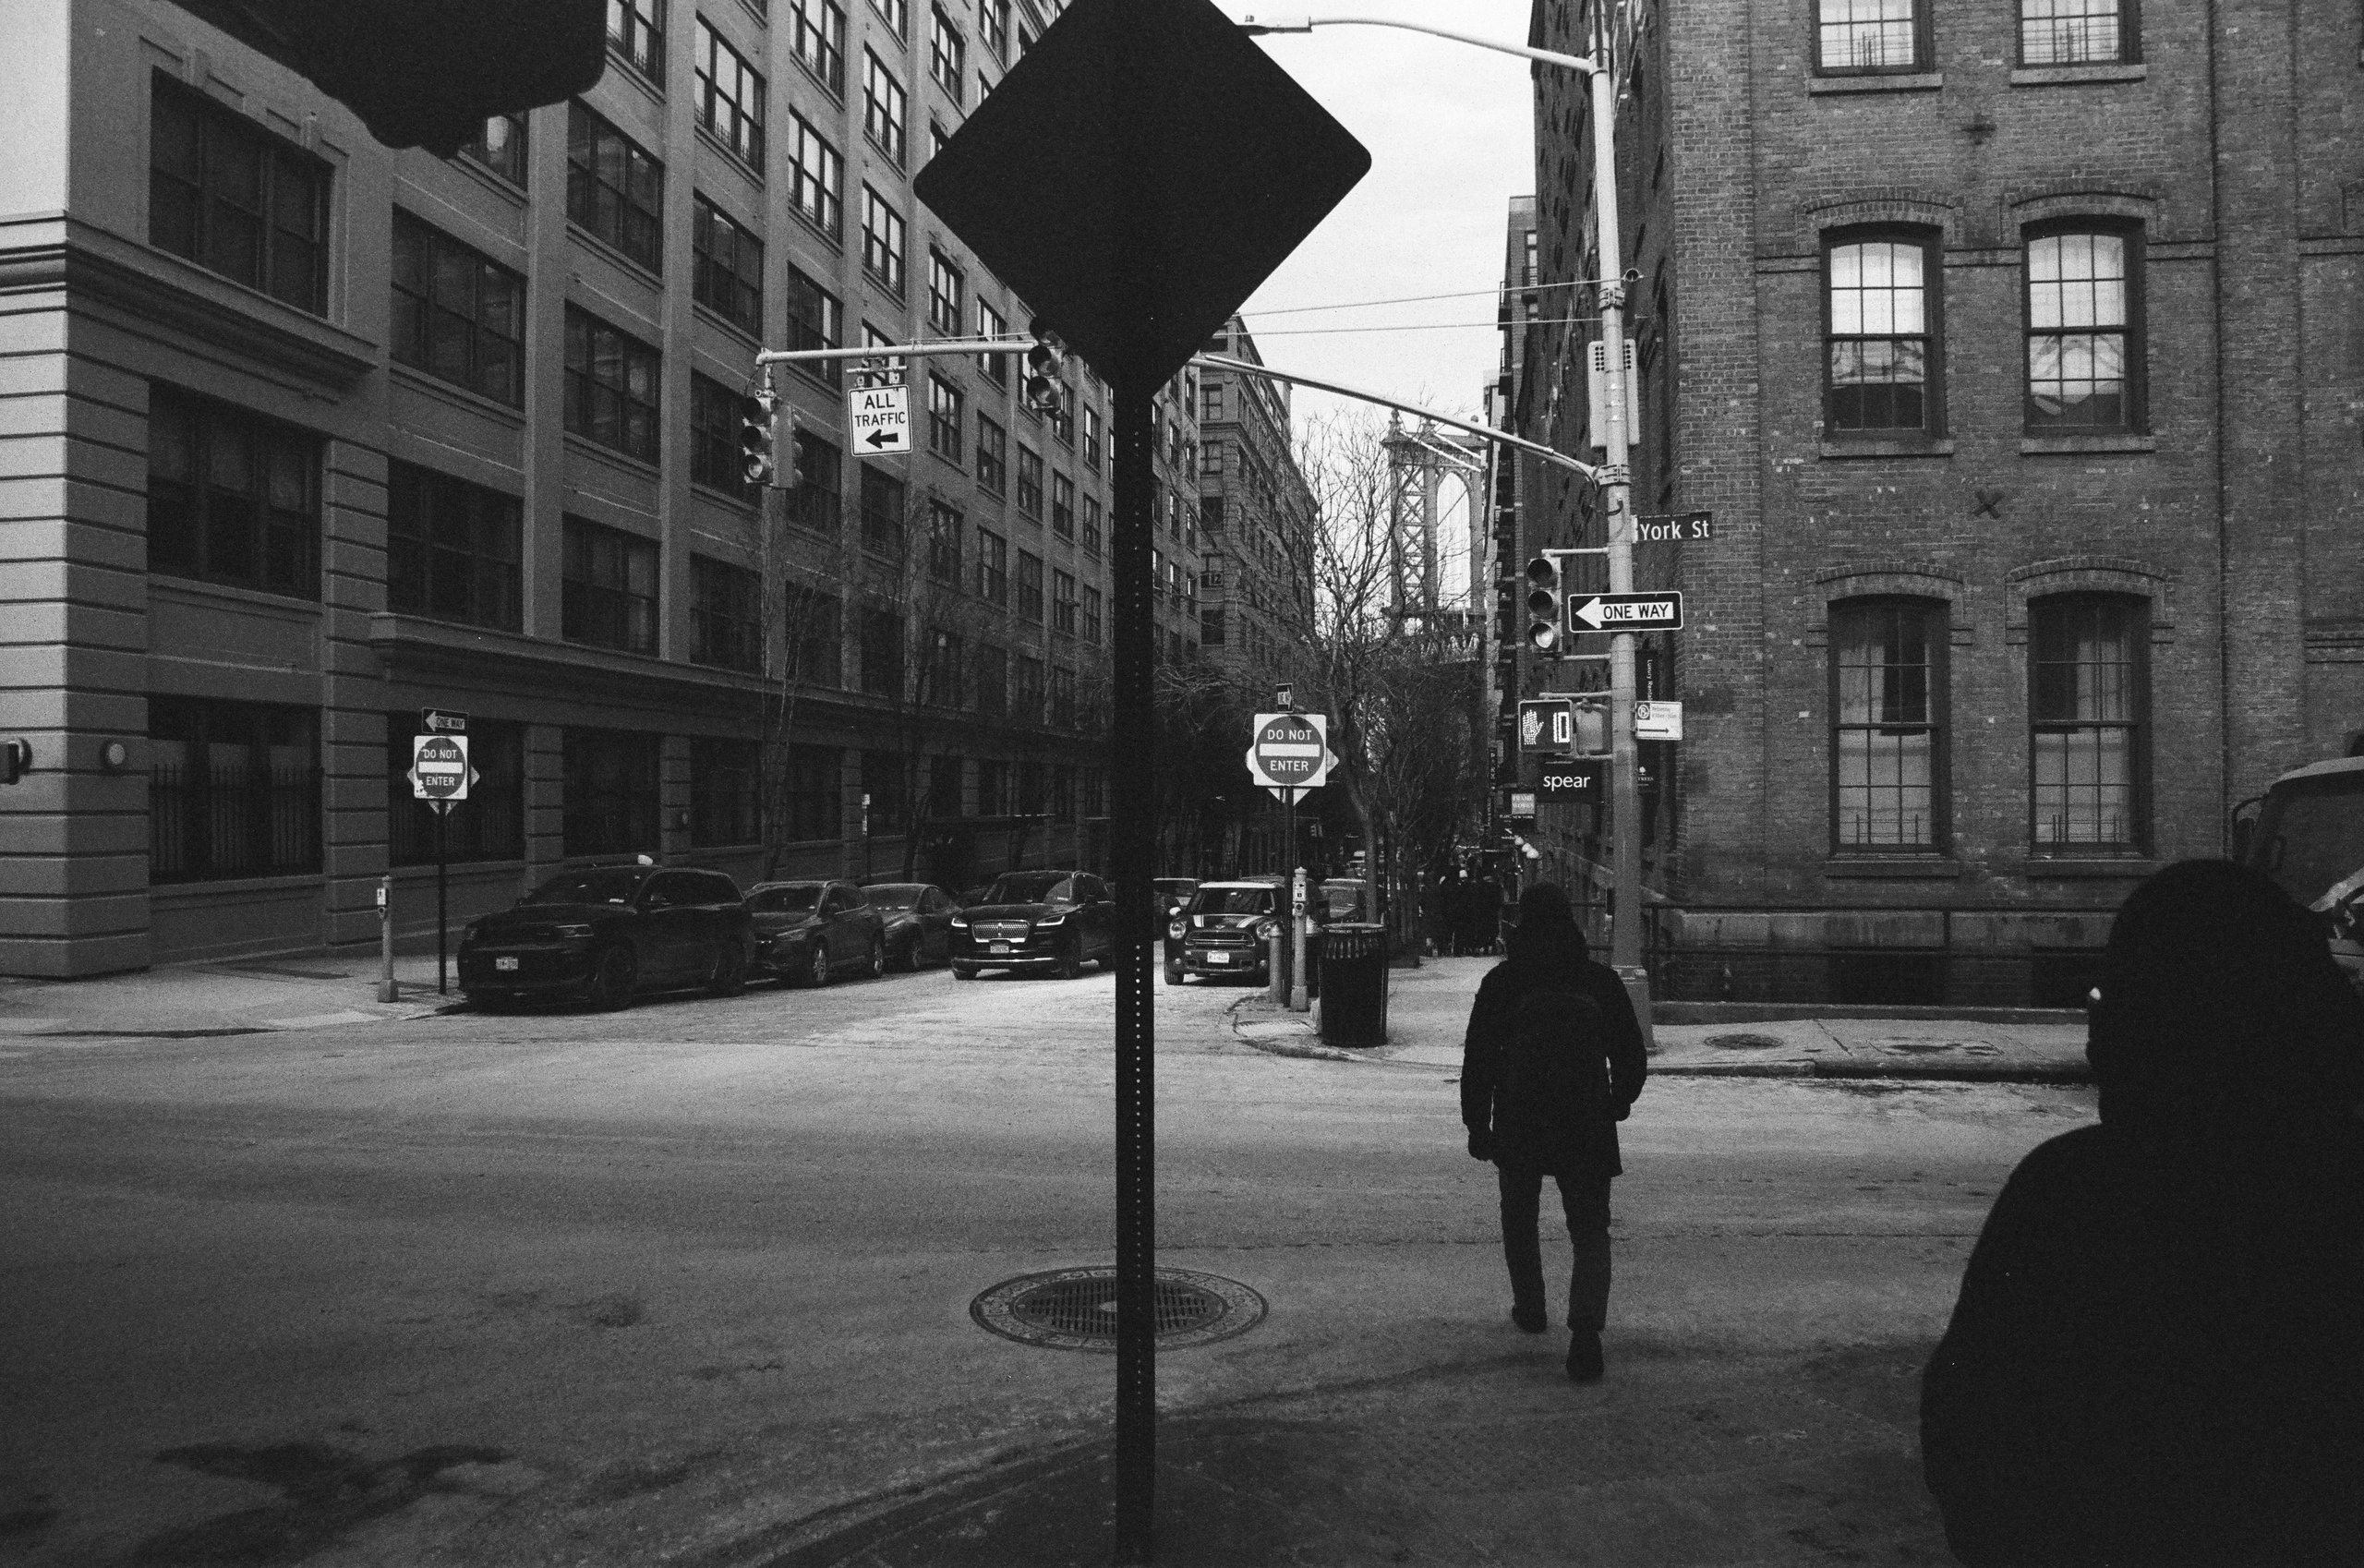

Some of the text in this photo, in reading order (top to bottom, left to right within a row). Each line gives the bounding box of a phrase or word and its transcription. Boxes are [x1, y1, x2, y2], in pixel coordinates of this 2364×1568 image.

[864, 393, 896, 409] ALL
[855, 412, 906, 427] TRAFFIC
[1639, 520, 1709, 540] York St
[1603, 604, 1669, 620] ONE WAY
[436, 717, 464, 729] ONE WAY
[1552, 712, 1570, 743] 10
[1267, 730, 1312, 740] DO NOT
[424, 749, 457, 758] DO NOT
[1270, 760, 1309, 771] ENTER
[426, 776, 454, 786] ENTER
[1543, 776, 1591, 791] spear
